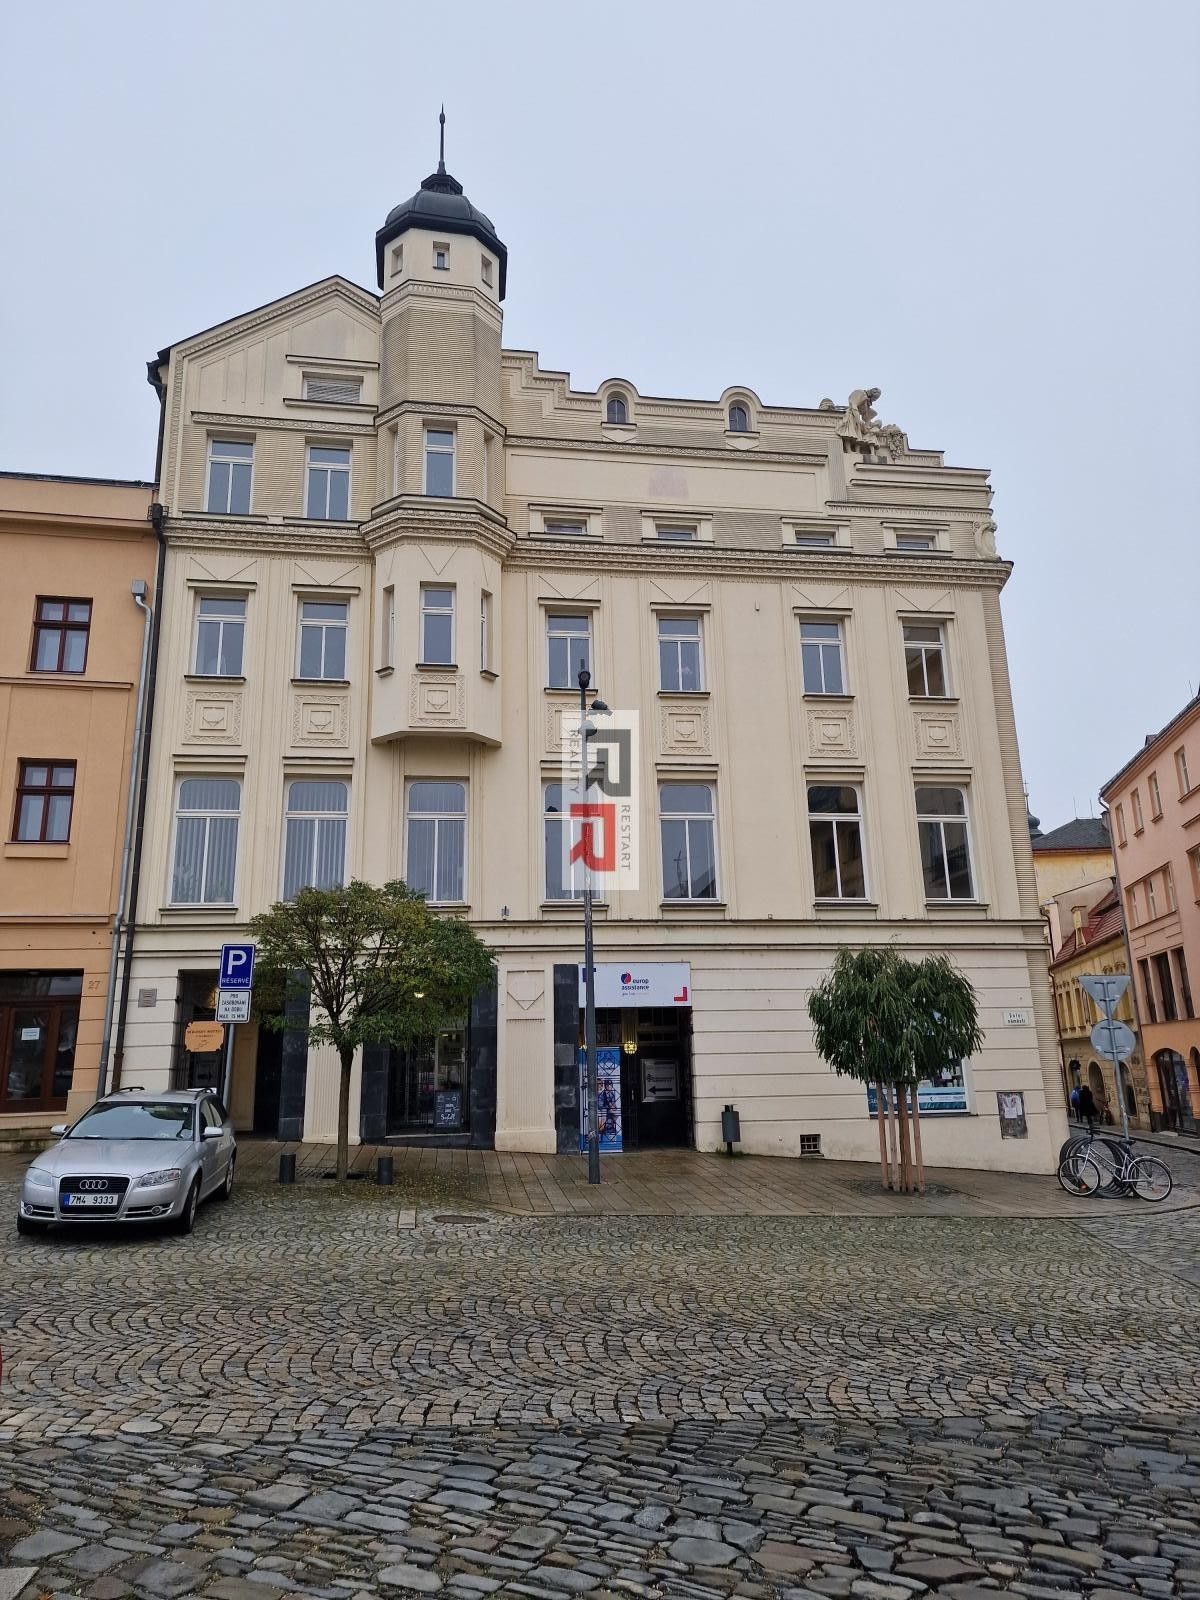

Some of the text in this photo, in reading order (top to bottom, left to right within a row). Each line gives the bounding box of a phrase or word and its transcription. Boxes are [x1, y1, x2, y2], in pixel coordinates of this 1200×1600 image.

[227, 949, 247, 975] P
[88, 980, 101, 990] 27
[70, 1195, 86, 1205] 7M4
[92, 1195, 114, 1205] 9333
